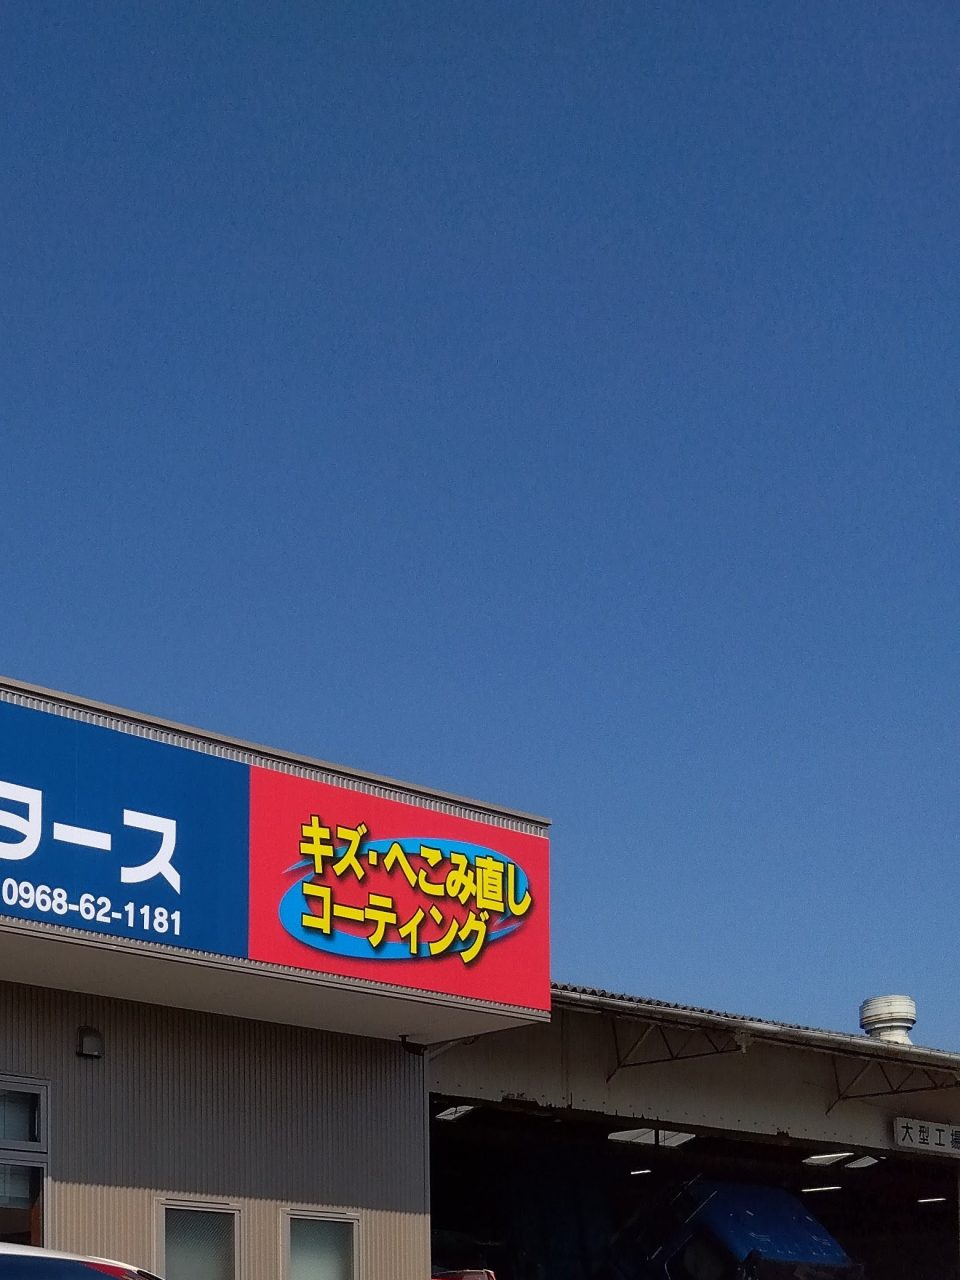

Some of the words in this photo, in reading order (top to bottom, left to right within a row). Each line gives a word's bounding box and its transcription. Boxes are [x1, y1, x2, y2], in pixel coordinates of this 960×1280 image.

[299, 814, 532, 917] キズ・へこみ直し
[2, 878, 182, 936] 0968-62-1181
[301, 881, 490, 964] コーティング
[900, 1122, 960, 1150] 大型工場
